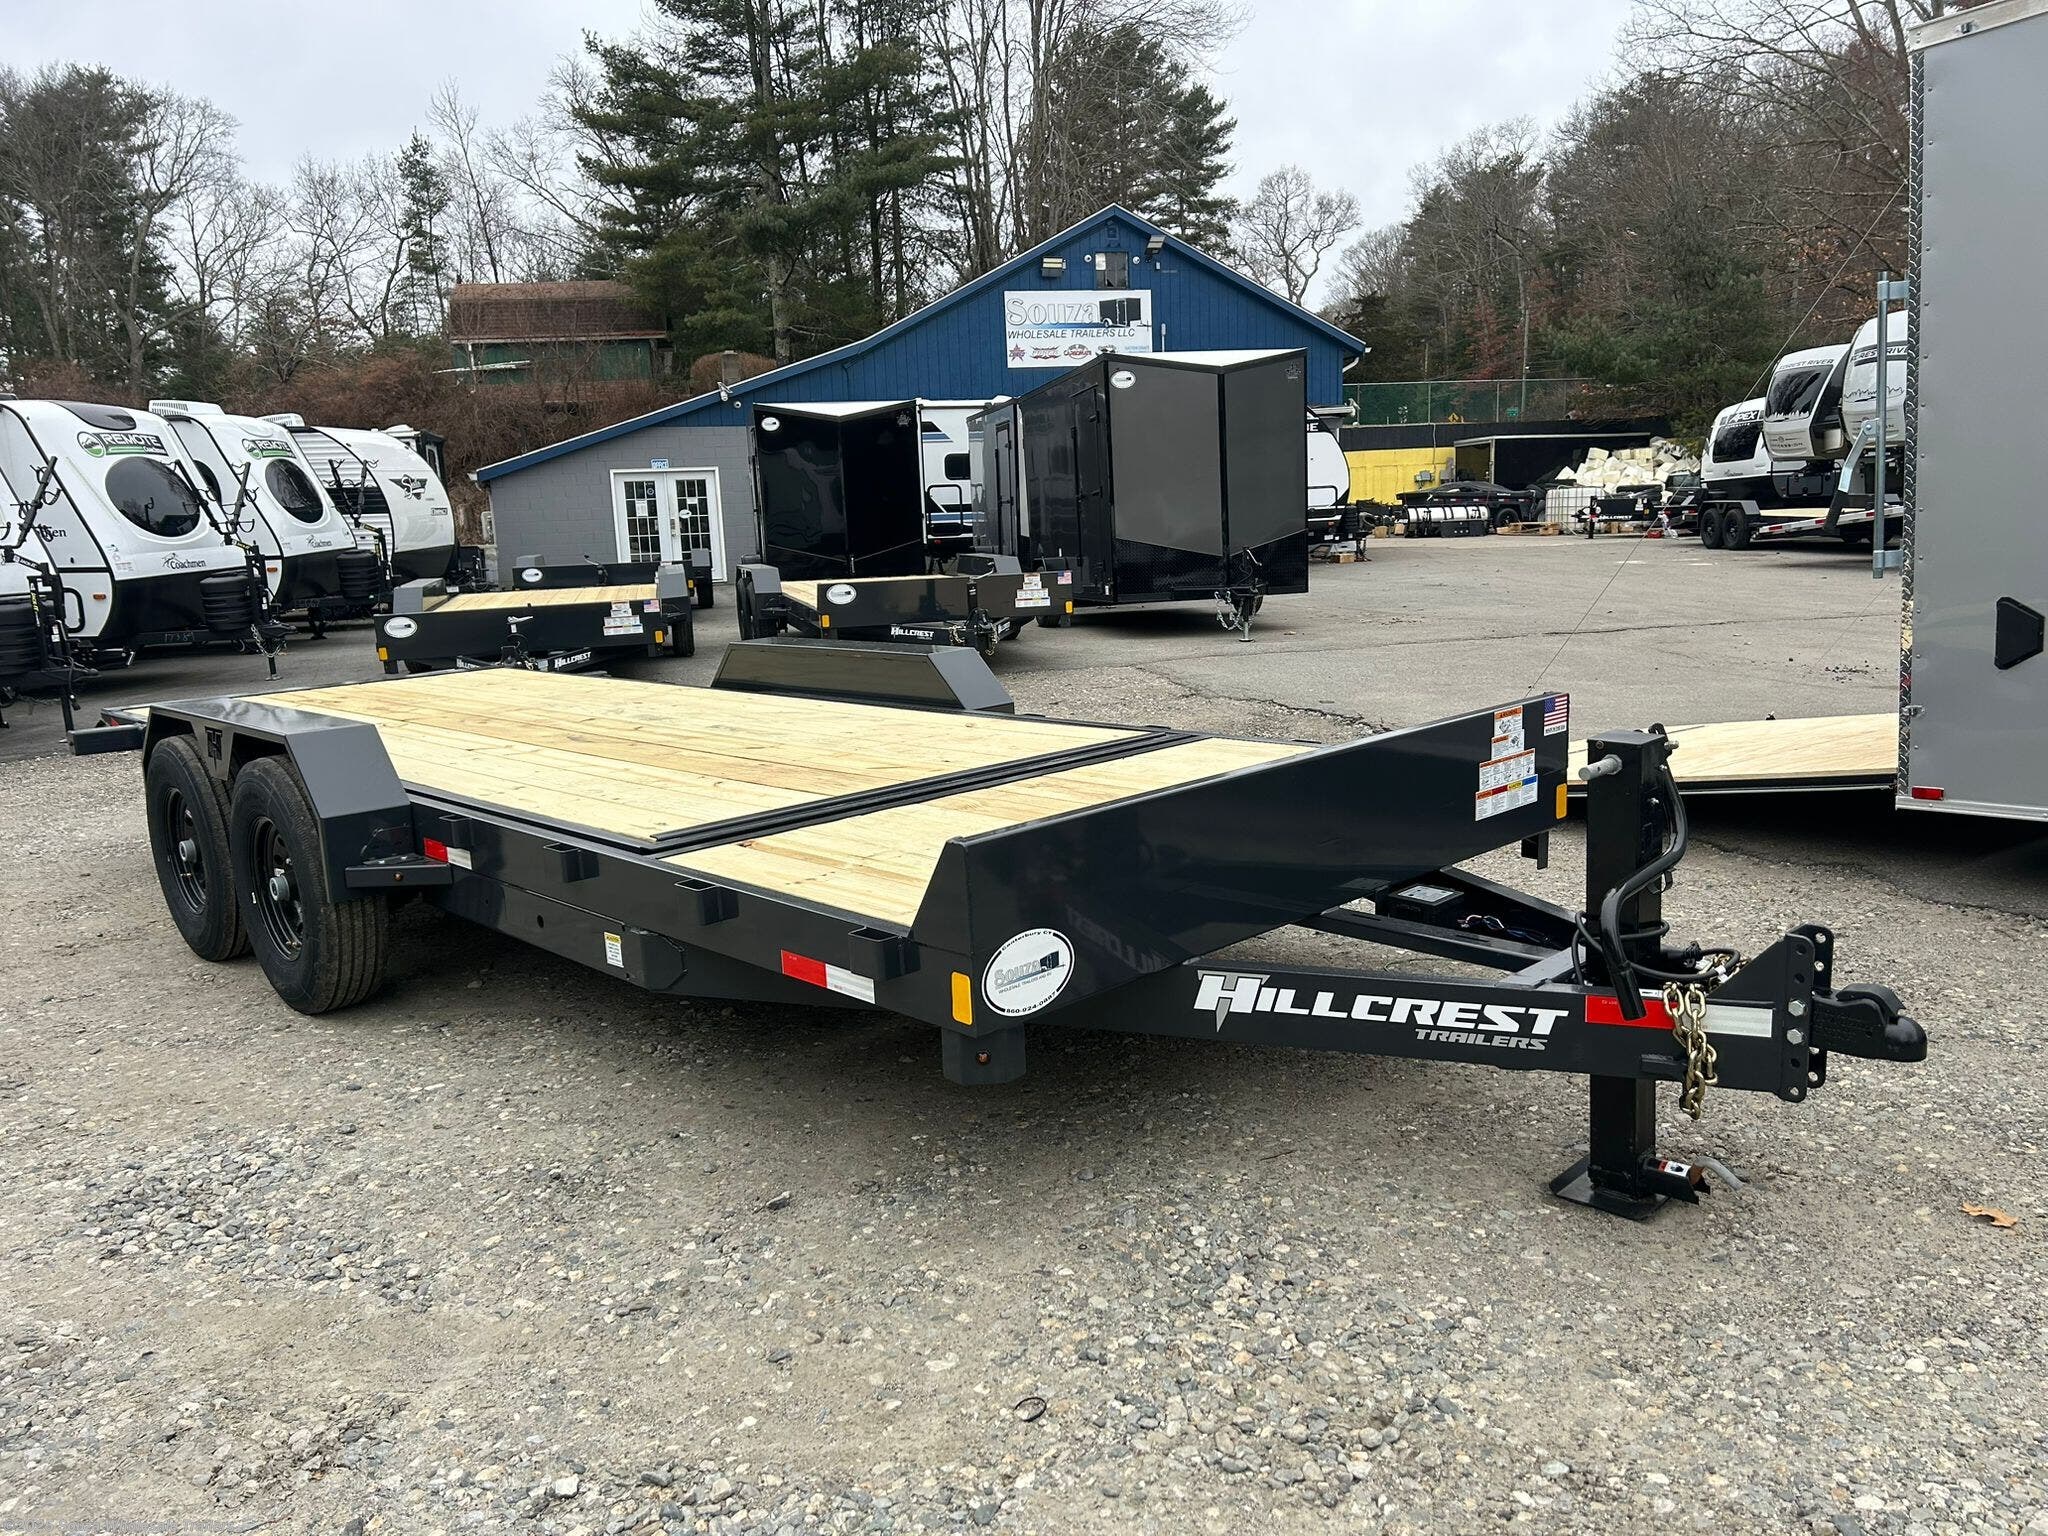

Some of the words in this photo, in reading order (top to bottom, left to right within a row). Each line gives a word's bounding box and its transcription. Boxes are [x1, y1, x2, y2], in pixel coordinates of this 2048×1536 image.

[1006, 297, 1099, 326] Souza
[1007, 329, 1067, 340] WHOLESALE
[1071, 329, 1116, 338] TRAILERS
[1117, 328, 1135, 338] LLC
[1807, 358, 1835, 366] RIVER
[1729, 411, 1758, 422] APEX
[101, 433, 162, 447] REMOTE
[256, 440, 291, 451] REMOTE
[170, 559, 207, 570] Coachmen
[890, 625, 934, 638] HILLCREST
[554, 651, 591, 669] HILLCREST
[1001, 930, 1041, 951] Canterbury
[994, 959, 1040, 987] Souza
[1193, 970, 1569, 1036] HILLCREST
[1415, 1028, 1548, 1051] TRAILERS
